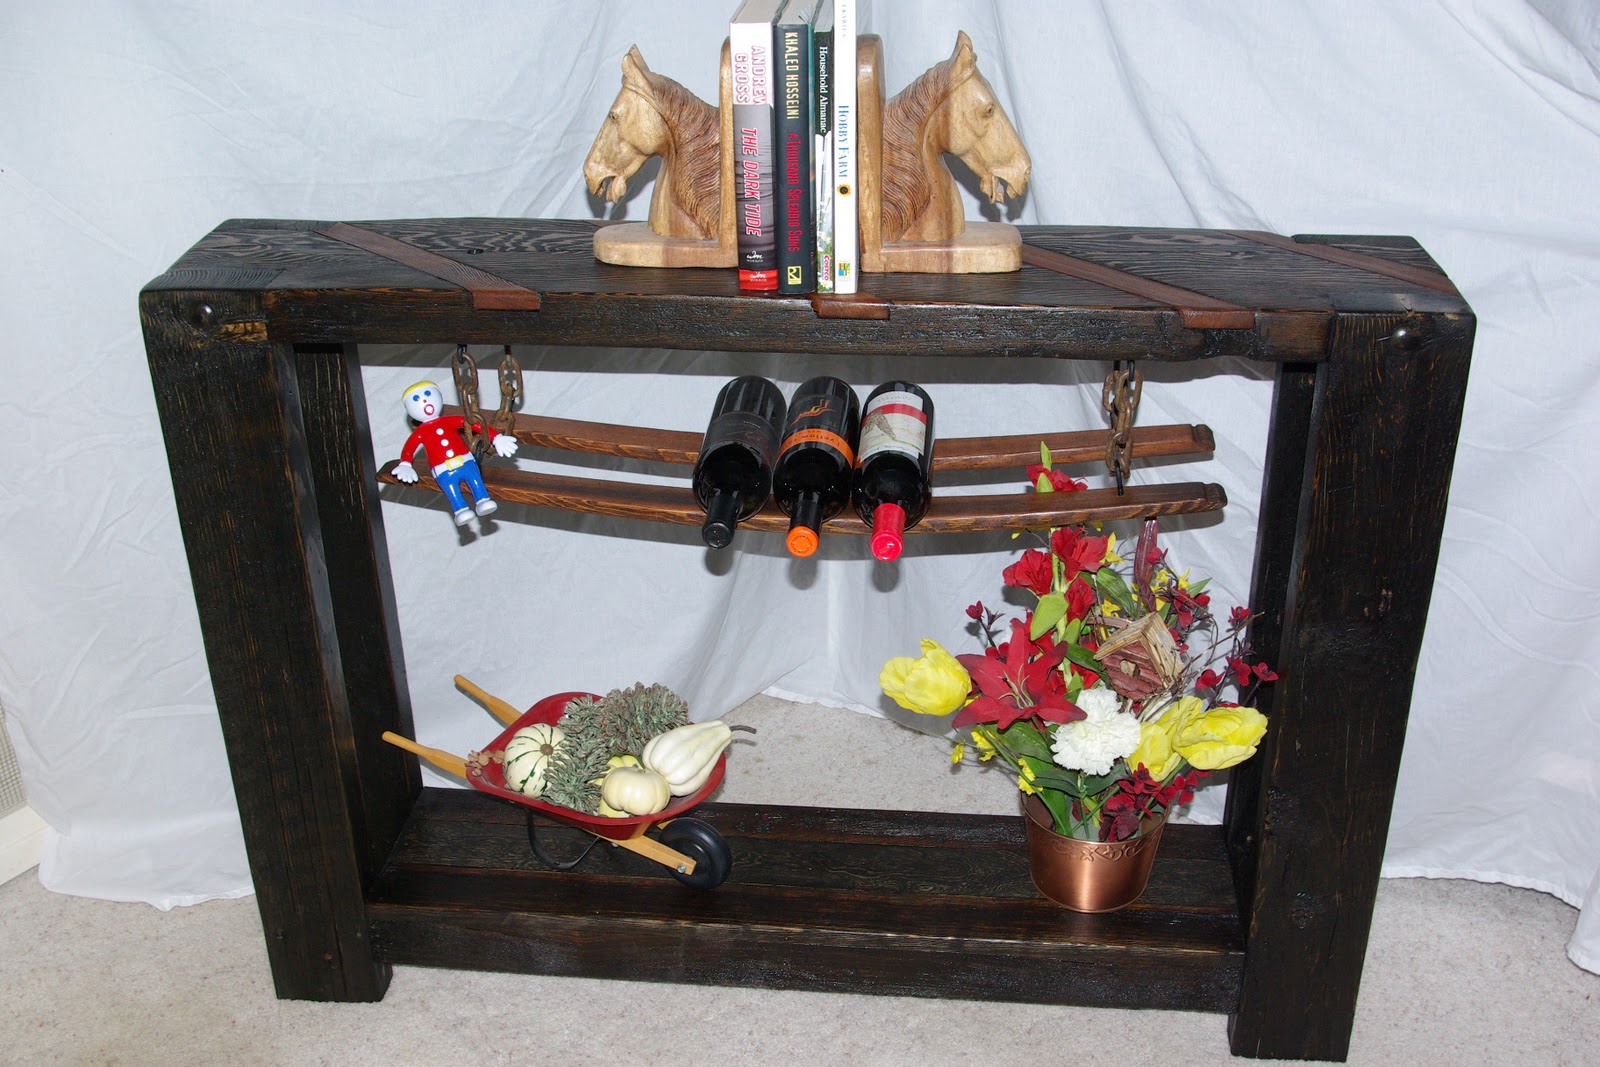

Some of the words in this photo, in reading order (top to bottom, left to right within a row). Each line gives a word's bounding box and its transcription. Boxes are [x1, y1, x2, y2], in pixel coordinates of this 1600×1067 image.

[784, 31, 799, 71] KHALED
[819, 46, 828, 93] Household
[734, 52, 750, 103] GROSS
[785, 74, 800, 119] HOSSEINI
[820, 94, 828, 133] Almanac
[838, 105, 849, 142] HOBBY
[742, 127, 758, 156] THE
[743, 160, 760, 200] DARK
[838, 147, 849, 177] FARM
[744, 203, 762, 236] TIDE
